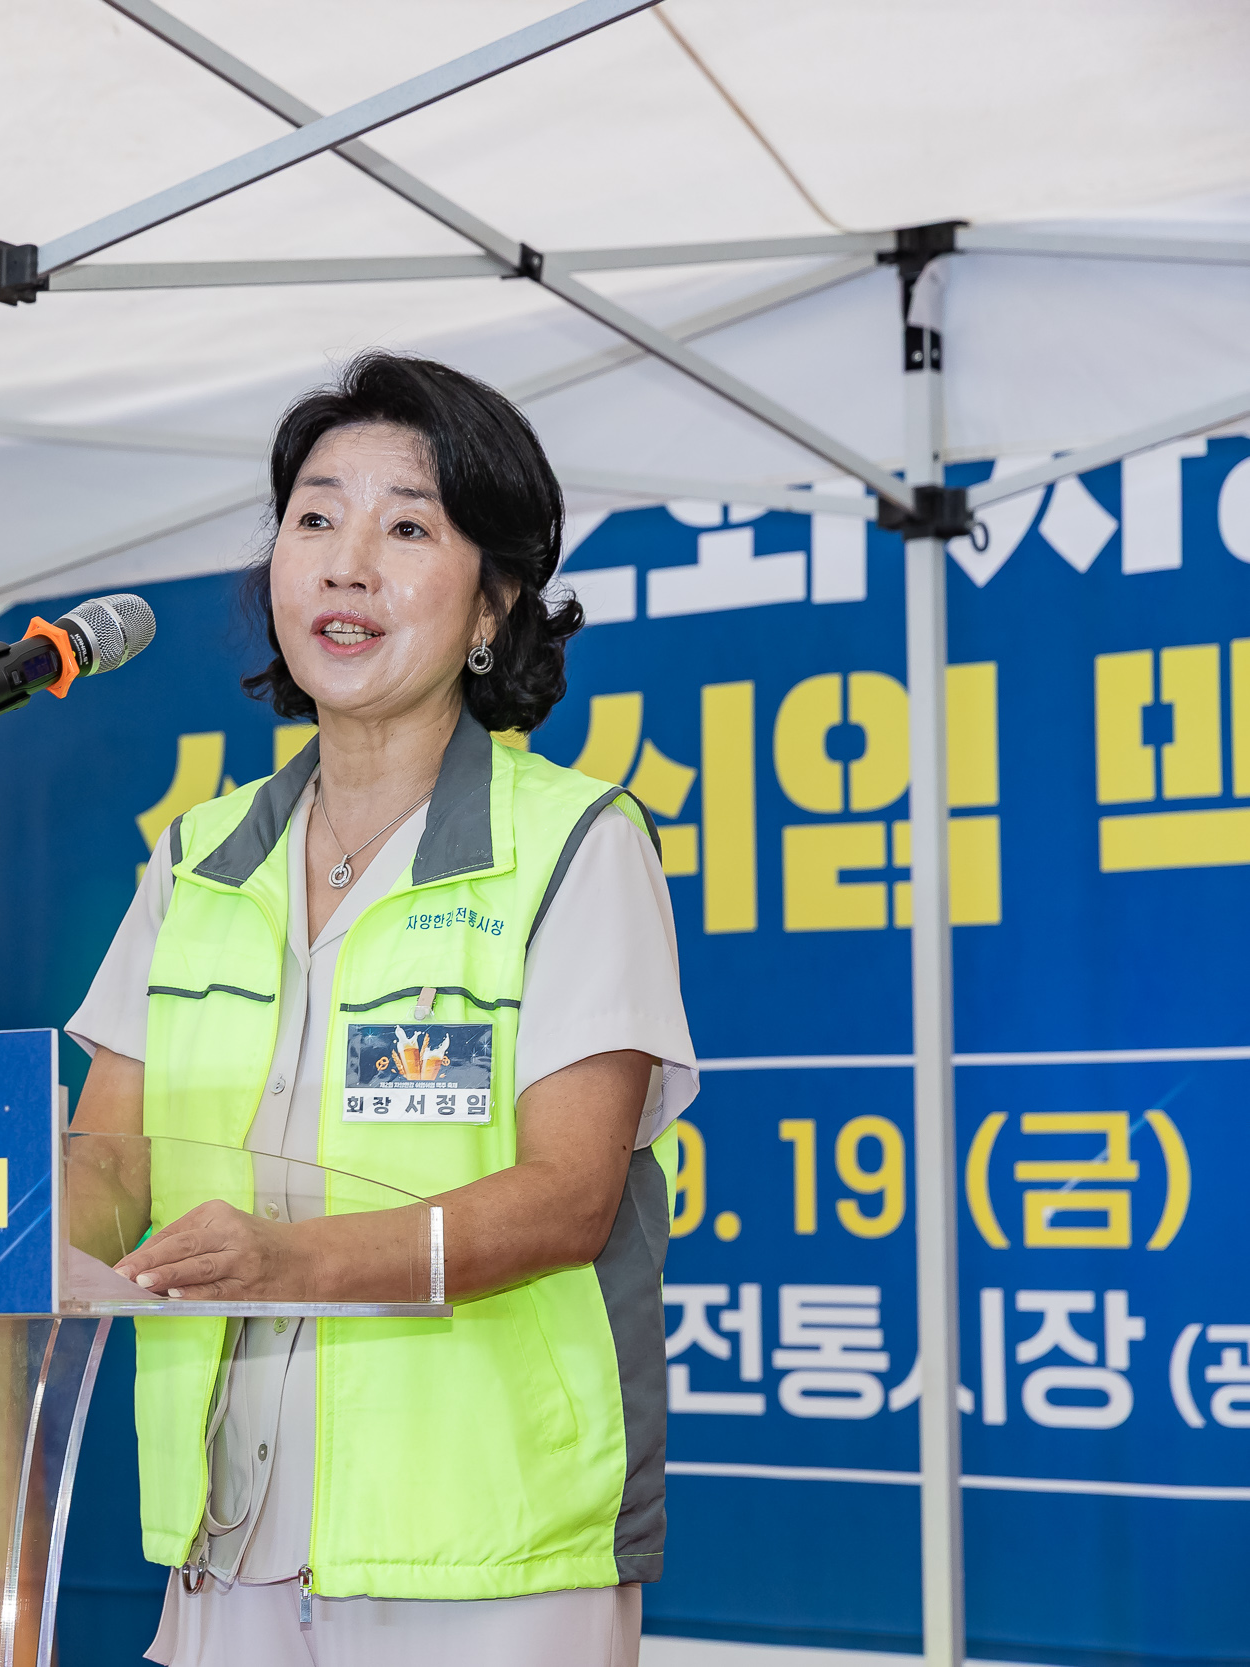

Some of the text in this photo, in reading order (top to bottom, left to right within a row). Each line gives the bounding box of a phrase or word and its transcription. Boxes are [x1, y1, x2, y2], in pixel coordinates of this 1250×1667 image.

[406, 907, 505, 936] 자양한강전통시장
[346, 1094, 487, 1115] 회장 서정임
[778, 1114, 906, 1239] 19
[965, 1110, 1191, 1250] (금)
